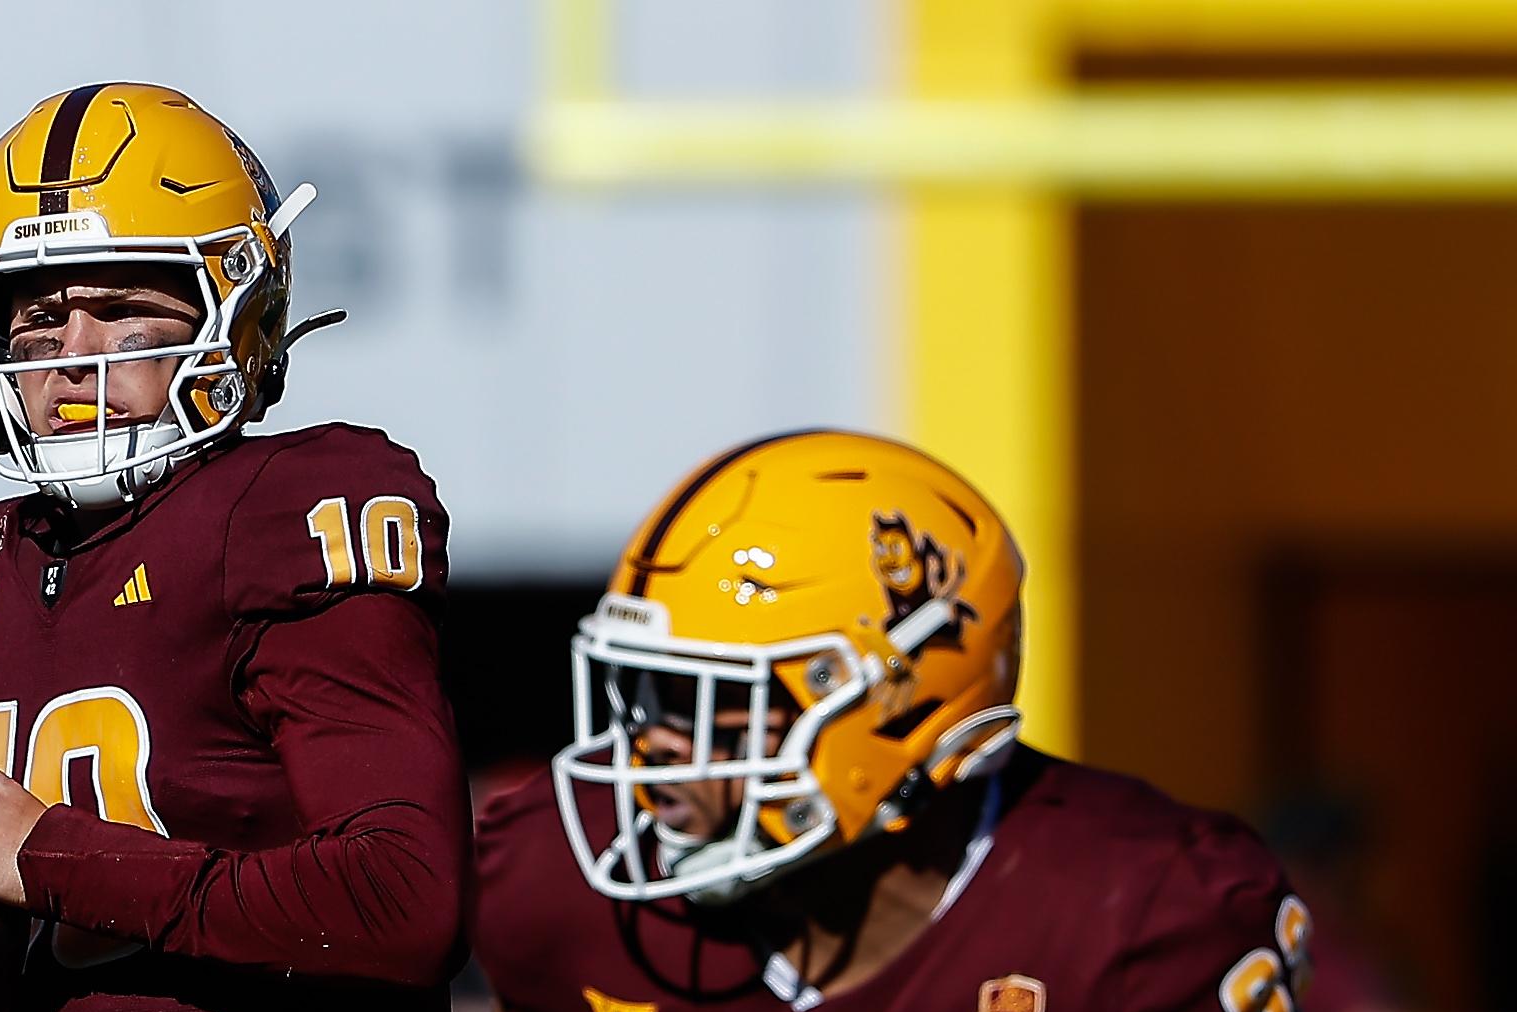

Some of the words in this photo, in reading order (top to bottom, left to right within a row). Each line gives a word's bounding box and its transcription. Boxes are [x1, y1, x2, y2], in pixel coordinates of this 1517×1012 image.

[14, 223, 41, 240] SUN
[45, 218, 90, 235] DEVILS
[306, 495, 424, 592] 10
